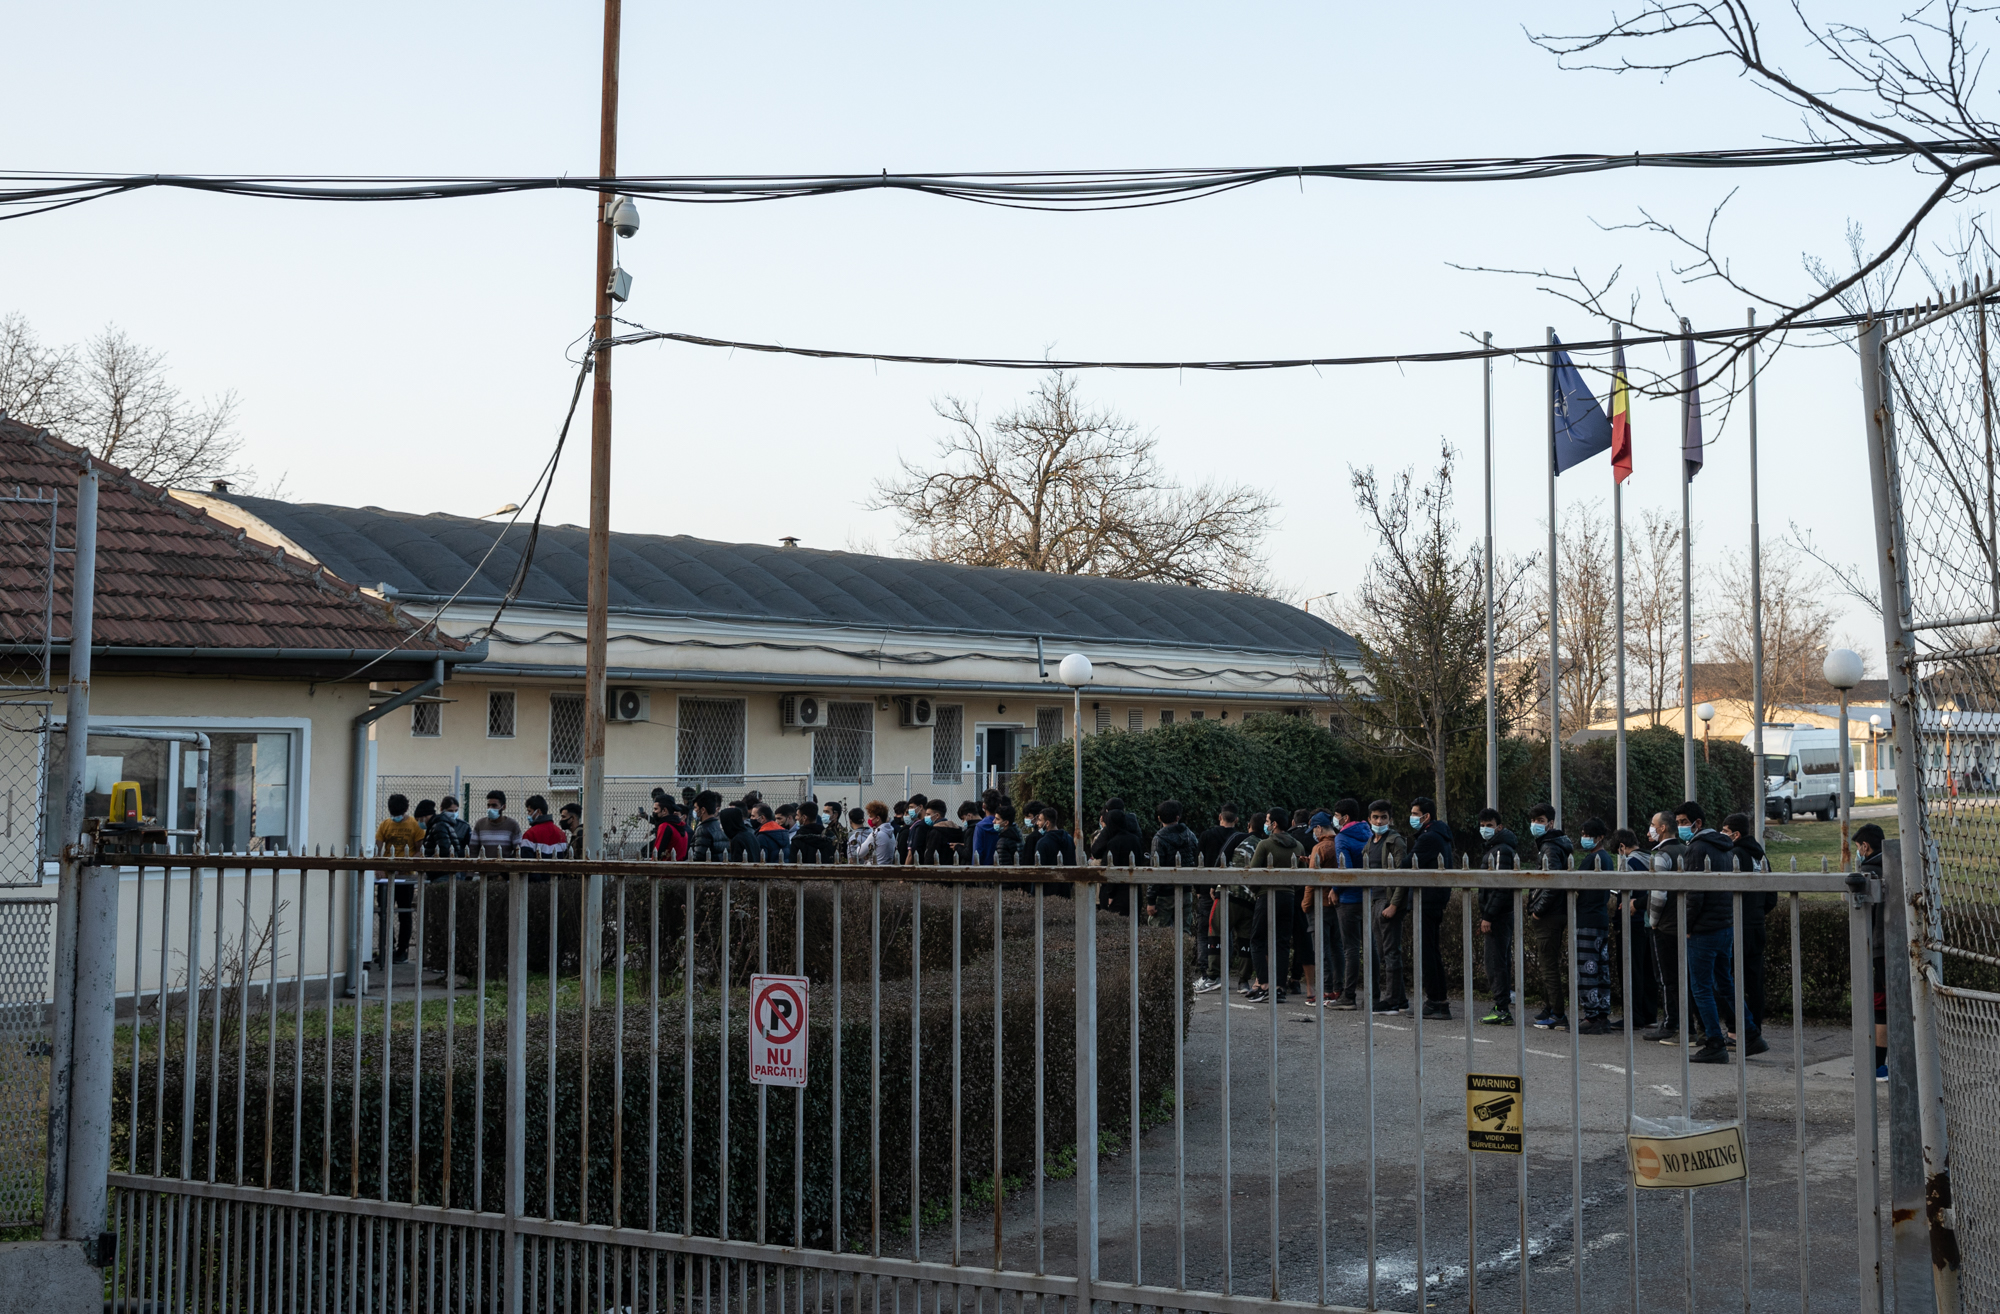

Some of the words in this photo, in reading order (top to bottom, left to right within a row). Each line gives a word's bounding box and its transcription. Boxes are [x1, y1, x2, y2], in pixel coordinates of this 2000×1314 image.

[770, 998, 792, 1030] P
[767, 1047, 792, 1066] NU
[1471, 1078, 1516, 1089] WARNING
[1471, 1142, 1519, 1151] SURVEILLANCE
[1662, 1153, 1680, 1173] NO
[1681, 1144, 1737, 1172] PARKING
